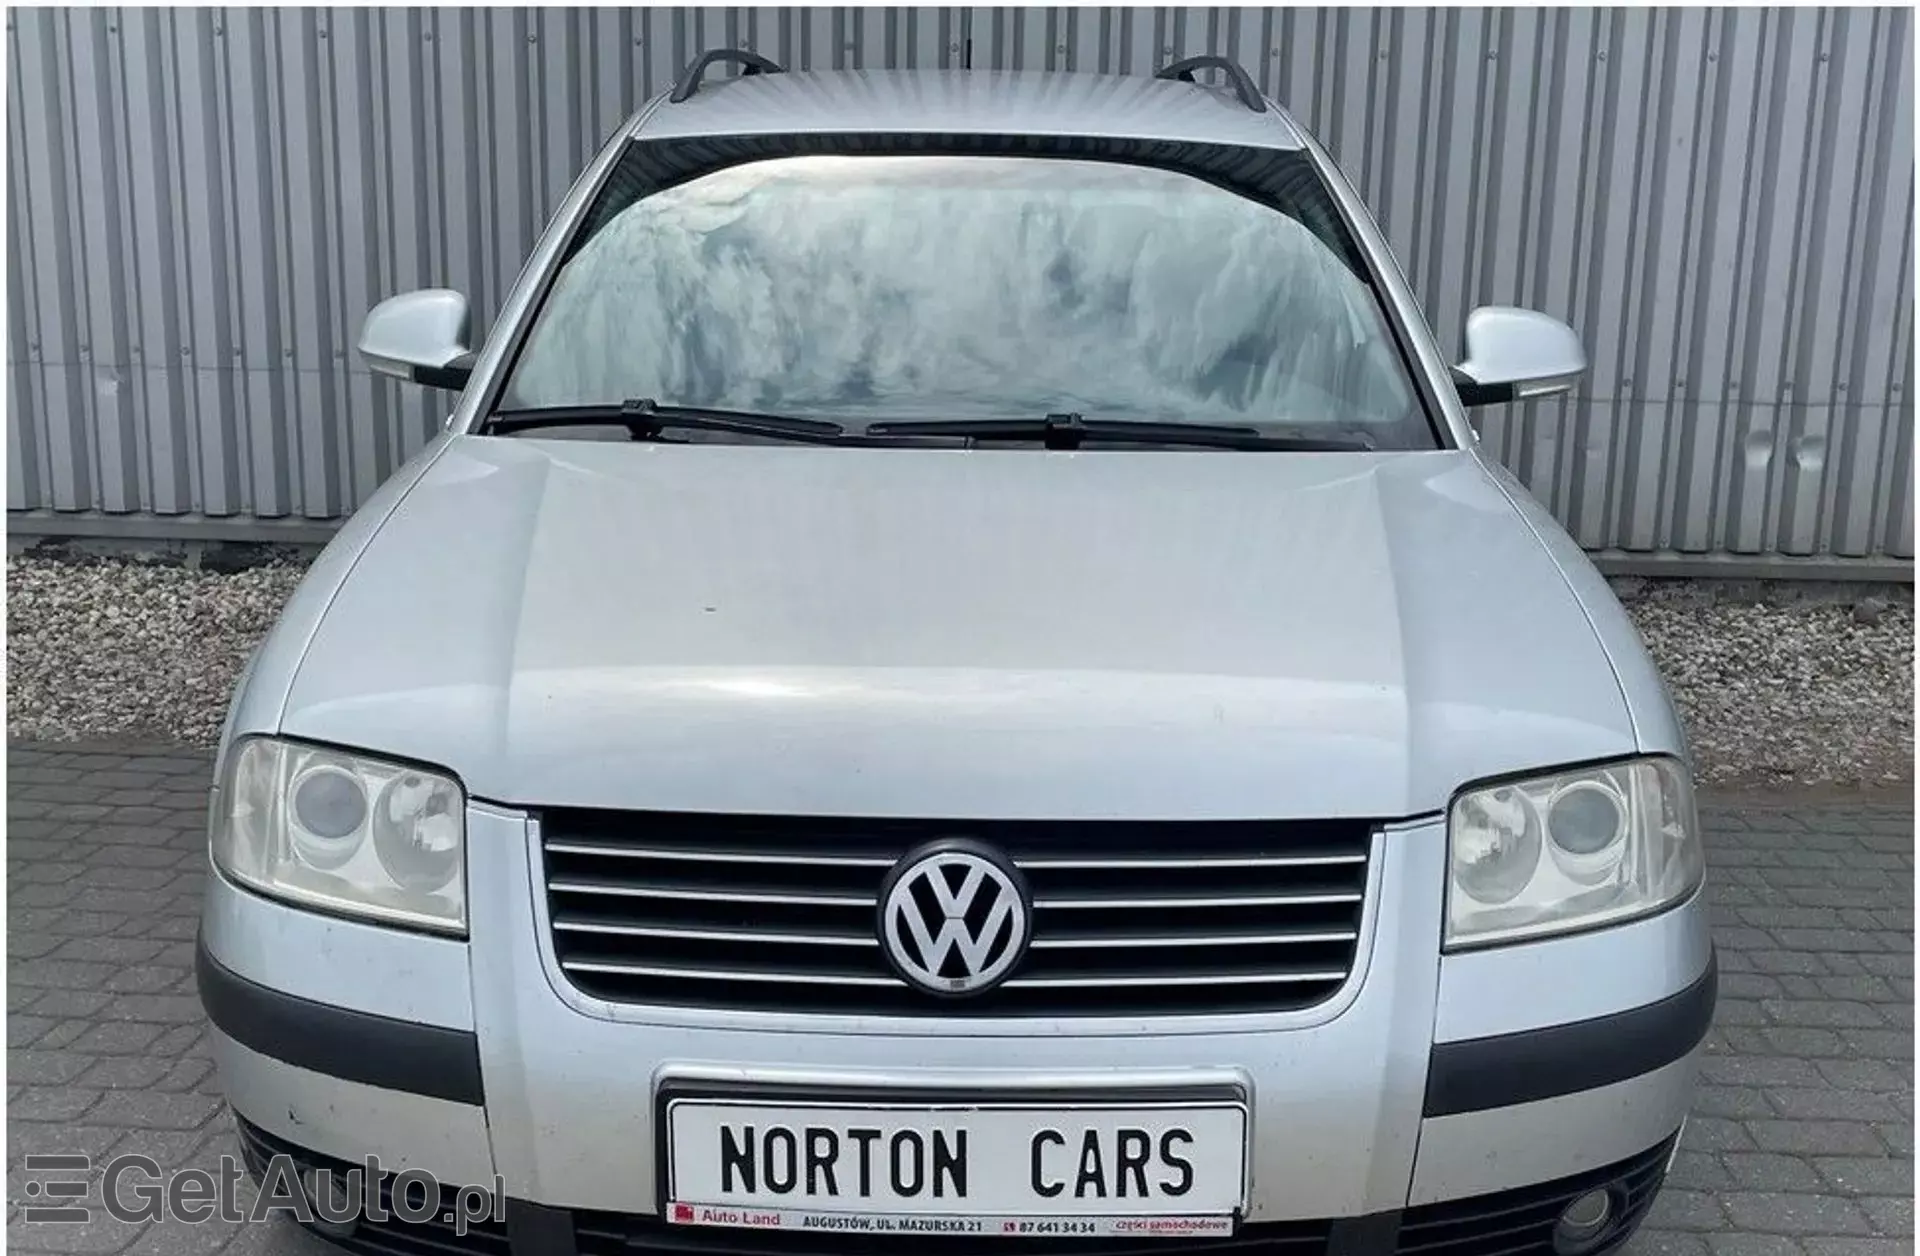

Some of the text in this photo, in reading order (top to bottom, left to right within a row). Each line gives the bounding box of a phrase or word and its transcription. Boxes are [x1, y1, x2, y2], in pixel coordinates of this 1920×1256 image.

[886, 853, 1024, 991] VW
[721, 1125, 1194, 1198] NORTON CARS
[702, 1209, 781, 1226] Auto Land
[803, 1215, 873, 1231] AUGUSTÓW,
[899, 1219, 965, 1232] MAZURSKA
[968, 1221, 982, 1232] 21
[1037, 1222, 1058, 1233] 641
